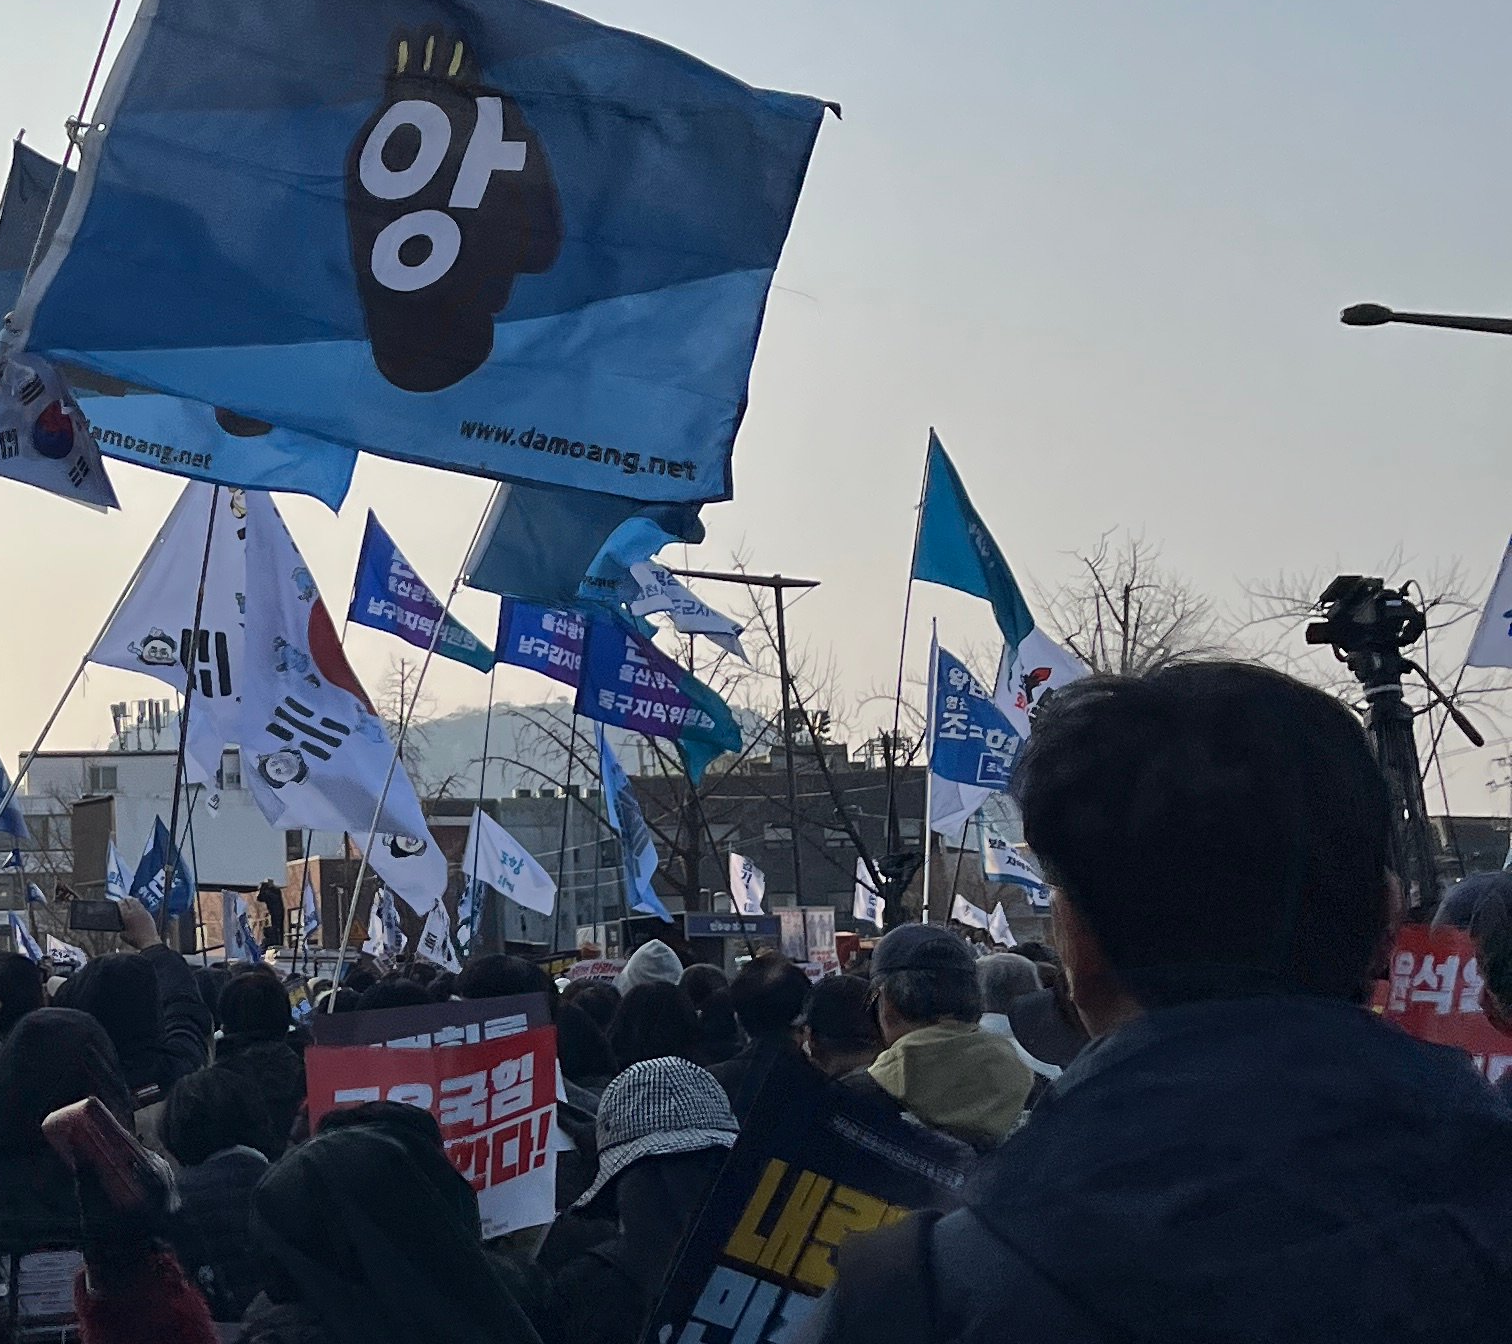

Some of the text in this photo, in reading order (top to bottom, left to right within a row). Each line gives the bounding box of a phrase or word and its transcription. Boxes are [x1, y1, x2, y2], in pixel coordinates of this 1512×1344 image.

[357, 95, 528, 293] 앙
[459, 419, 699, 483] www.damoang.net
[334, 1051, 535, 1127] 국힘
